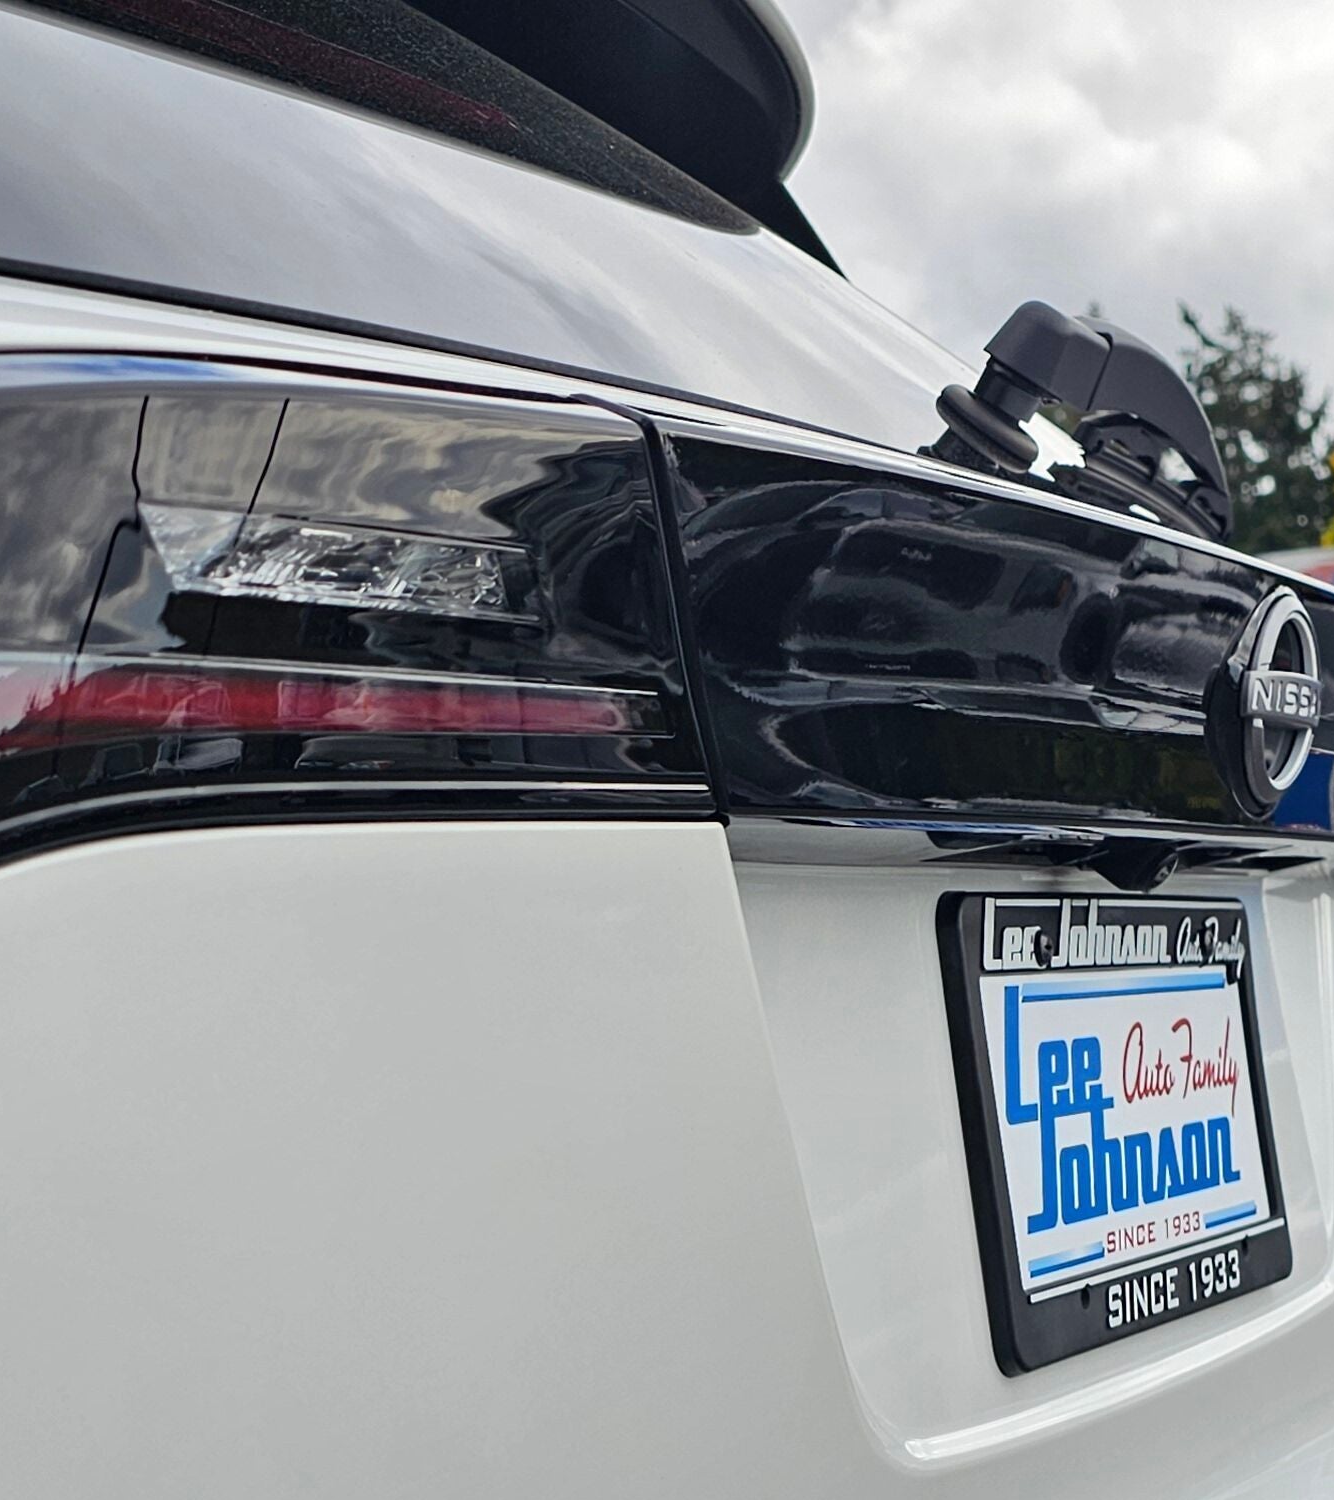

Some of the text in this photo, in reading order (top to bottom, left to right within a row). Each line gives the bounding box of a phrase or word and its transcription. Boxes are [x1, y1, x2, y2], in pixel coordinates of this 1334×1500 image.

[1251, 678, 1317, 717] NISS
[1051, 897, 1172, 967] Johnson
[1004, 985, 1115, 1125] Lee
[1122, 1016, 1241, 1117] Auto Family
[1027, 1090, 1242, 1235] Johnson
[1106, 1211, 1201, 1254] SINCE 1933
[1107, 1249, 1243, 1329] SINCE 1933
